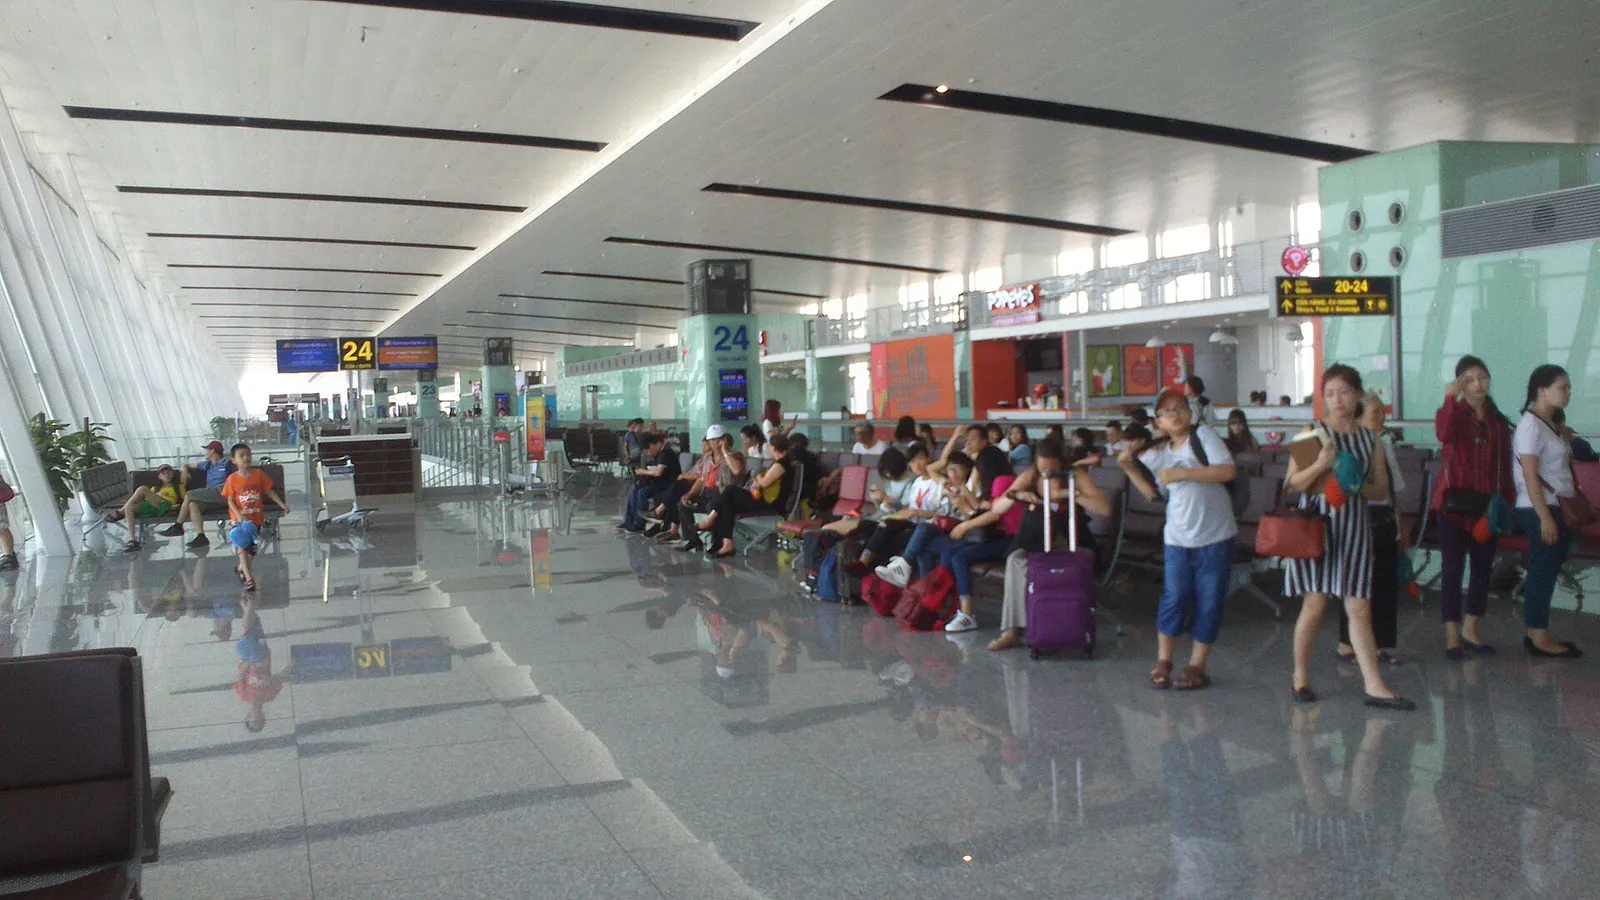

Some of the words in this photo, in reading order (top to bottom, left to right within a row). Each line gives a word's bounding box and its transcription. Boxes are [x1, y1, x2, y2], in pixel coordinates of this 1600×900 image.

[1334, 279, 1369, 293] 20-24
[714, 325, 749, 351] 24
[343, 341, 373, 361] 24
[422, 385, 436, 396] 23
